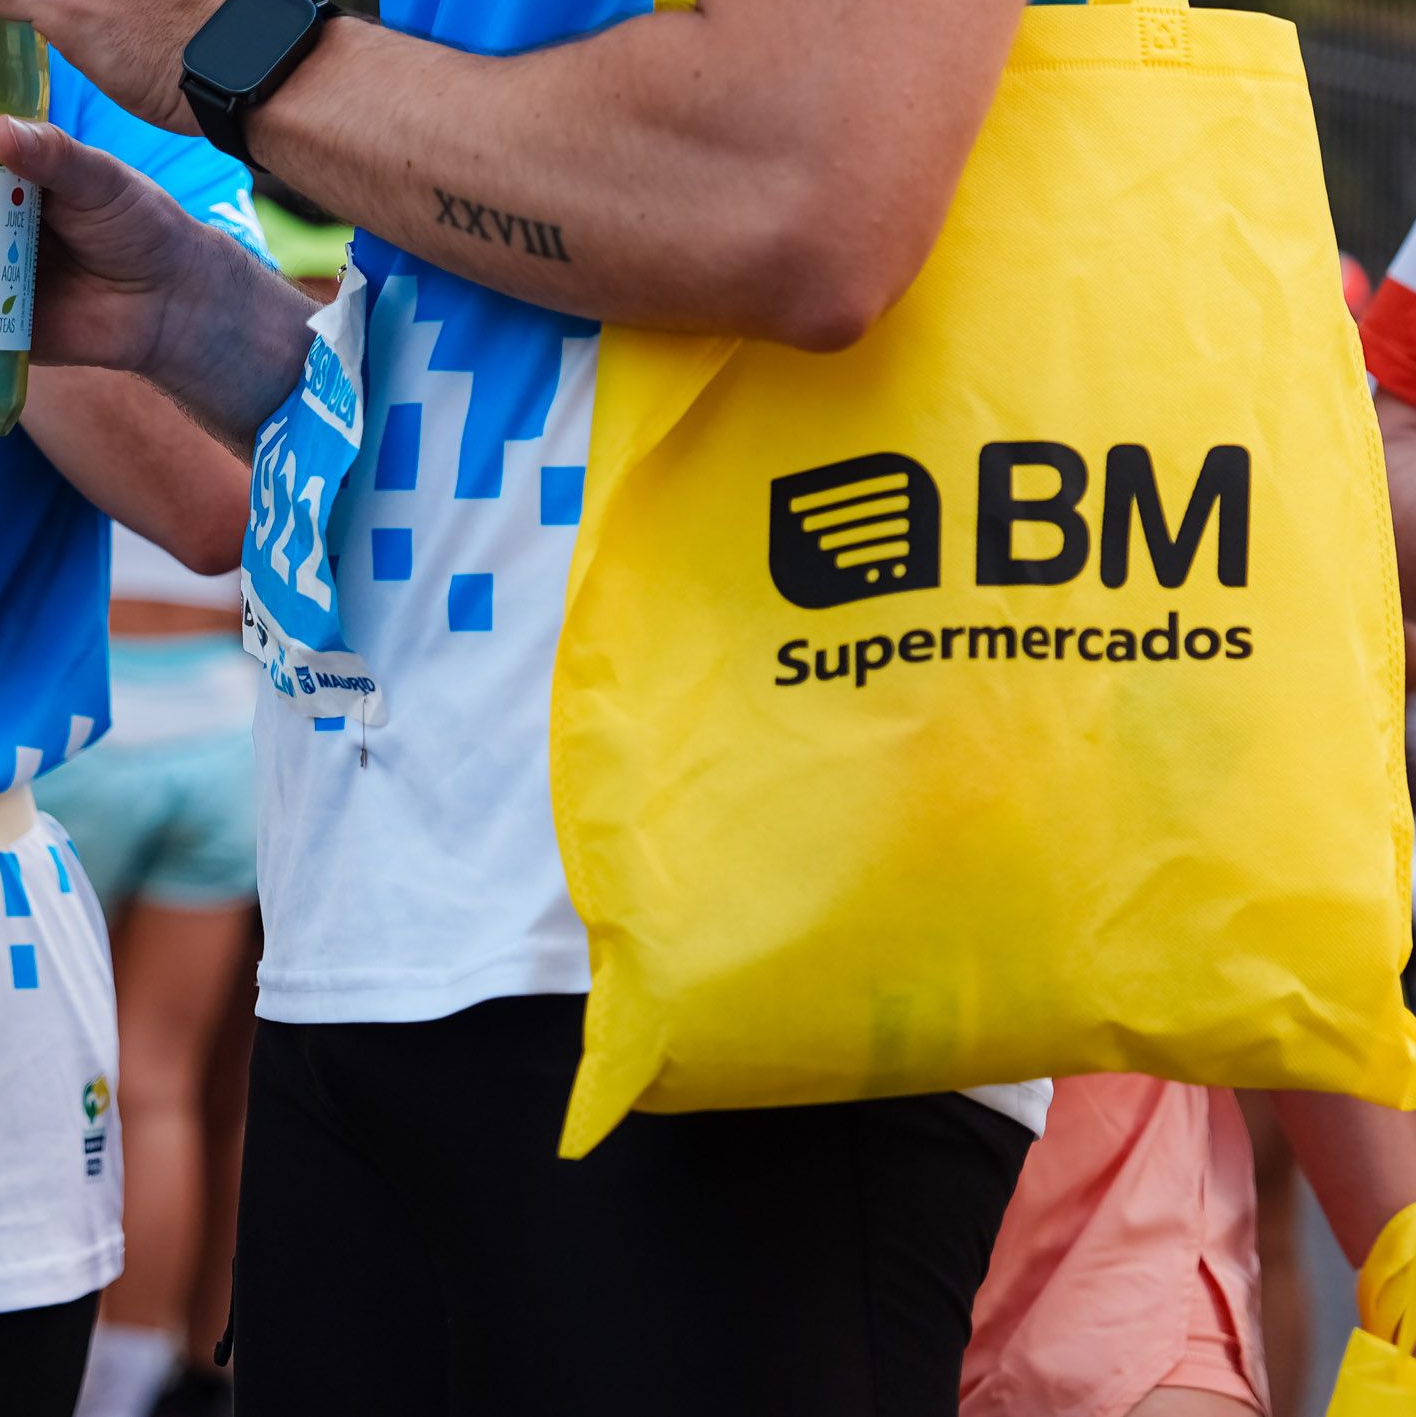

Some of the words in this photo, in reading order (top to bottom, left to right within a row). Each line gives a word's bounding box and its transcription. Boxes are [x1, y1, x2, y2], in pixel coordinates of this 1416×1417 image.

[5, 210, 25, 229] JUICE
[433, 187, 571, 263] XXVIII
[1, 266, 21, 283] AQUA
[0, 317, 16, 334] TEAS
[976, 441, 1252, 589] BM
[775, 611, 1253, 688] Supermercados
